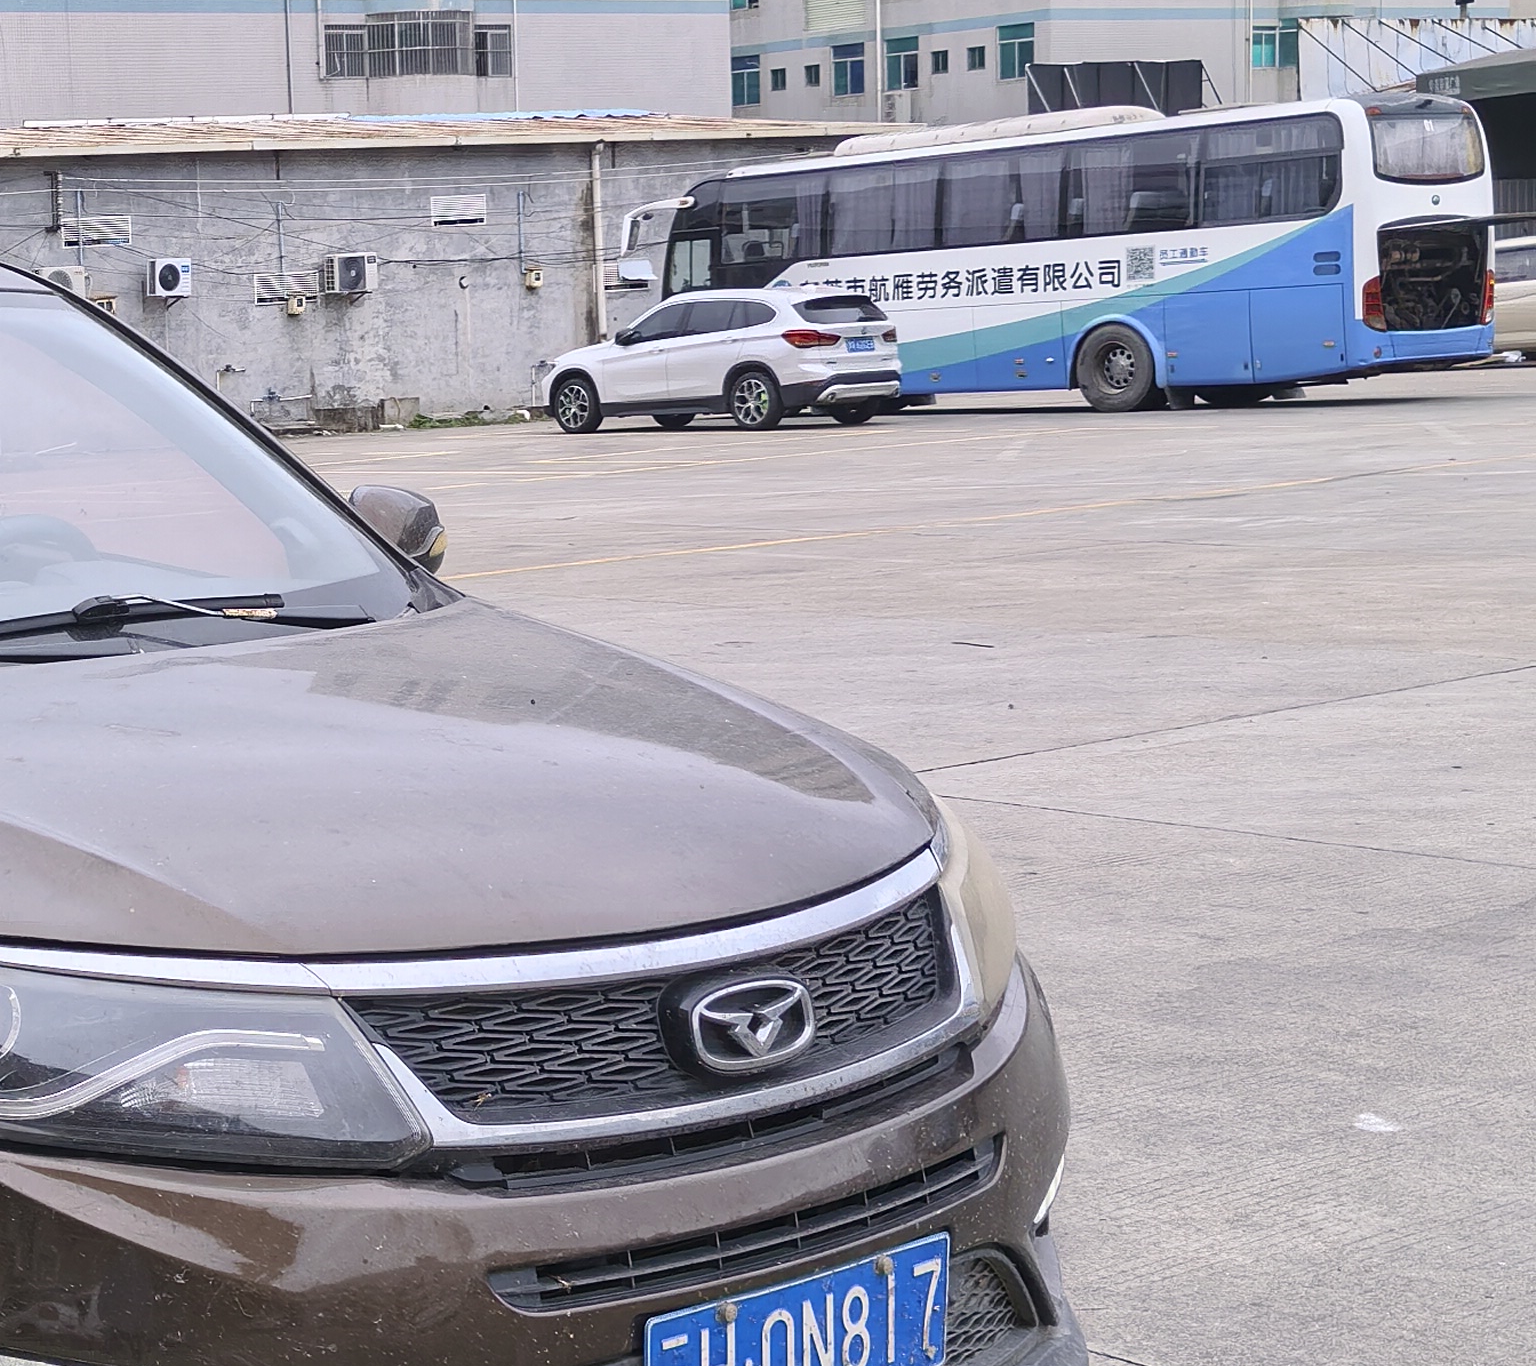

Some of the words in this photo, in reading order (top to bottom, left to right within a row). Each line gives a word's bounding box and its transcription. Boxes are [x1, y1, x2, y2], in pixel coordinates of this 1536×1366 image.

[800, 259, 1121, 303] 市航雁劳务派遣有限公司
